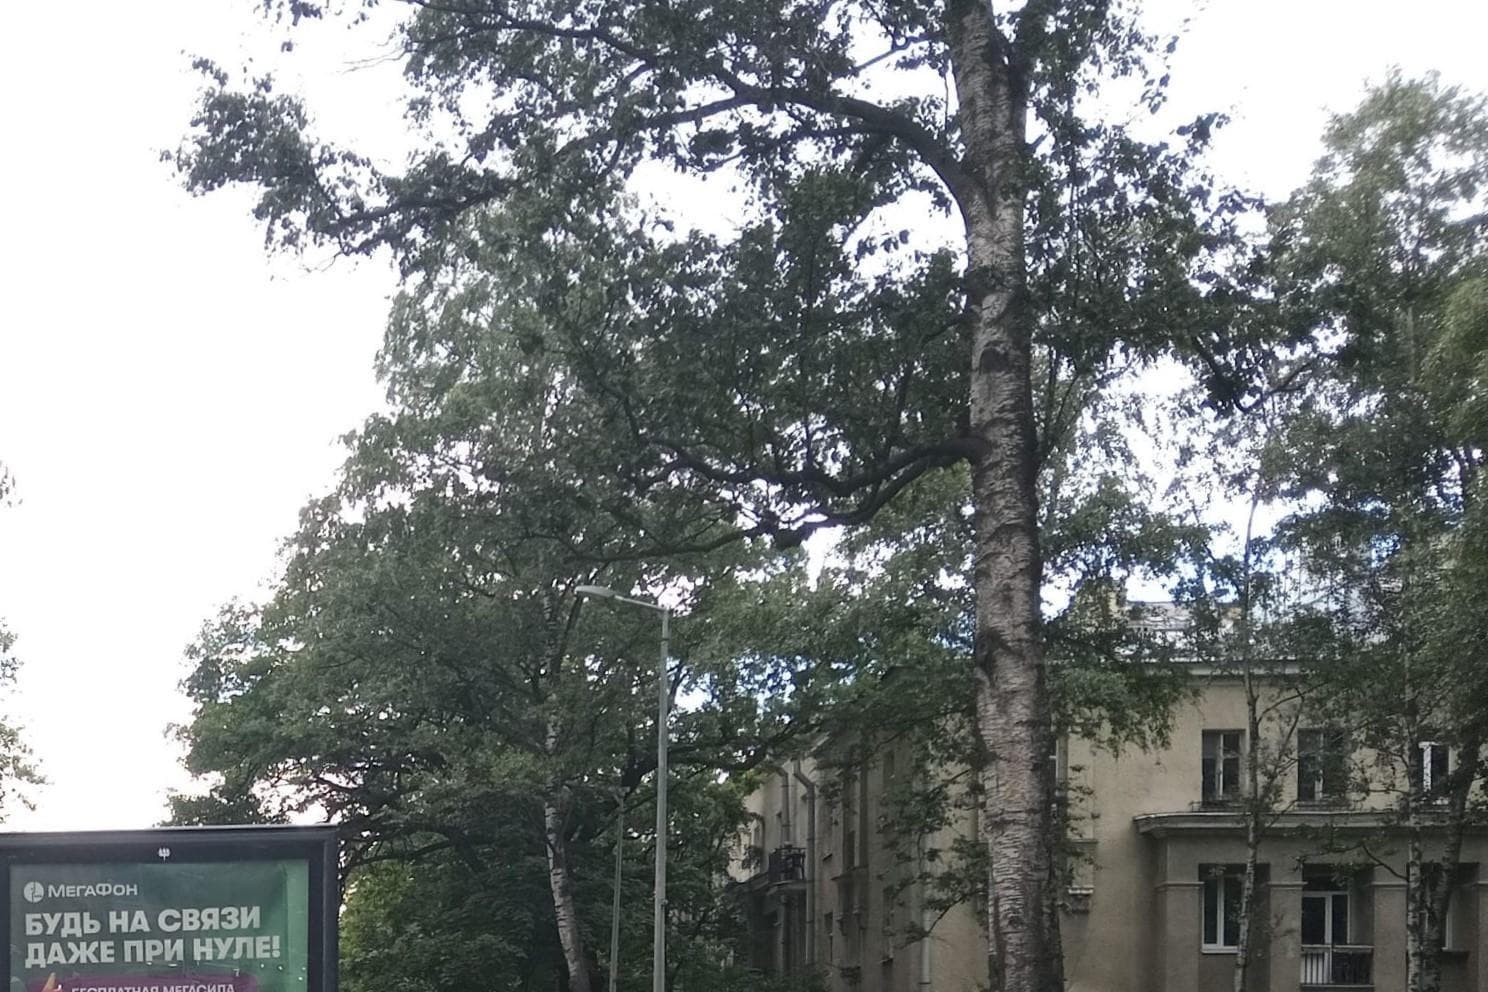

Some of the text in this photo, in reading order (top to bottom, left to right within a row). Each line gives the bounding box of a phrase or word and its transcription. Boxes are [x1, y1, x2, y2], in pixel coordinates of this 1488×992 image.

[25, 906, 261, 938] БУДЬ НА СВЯЗИ
[25, 935, 281, 969] ДАЖЕ ПРИ НУЛЕ!
